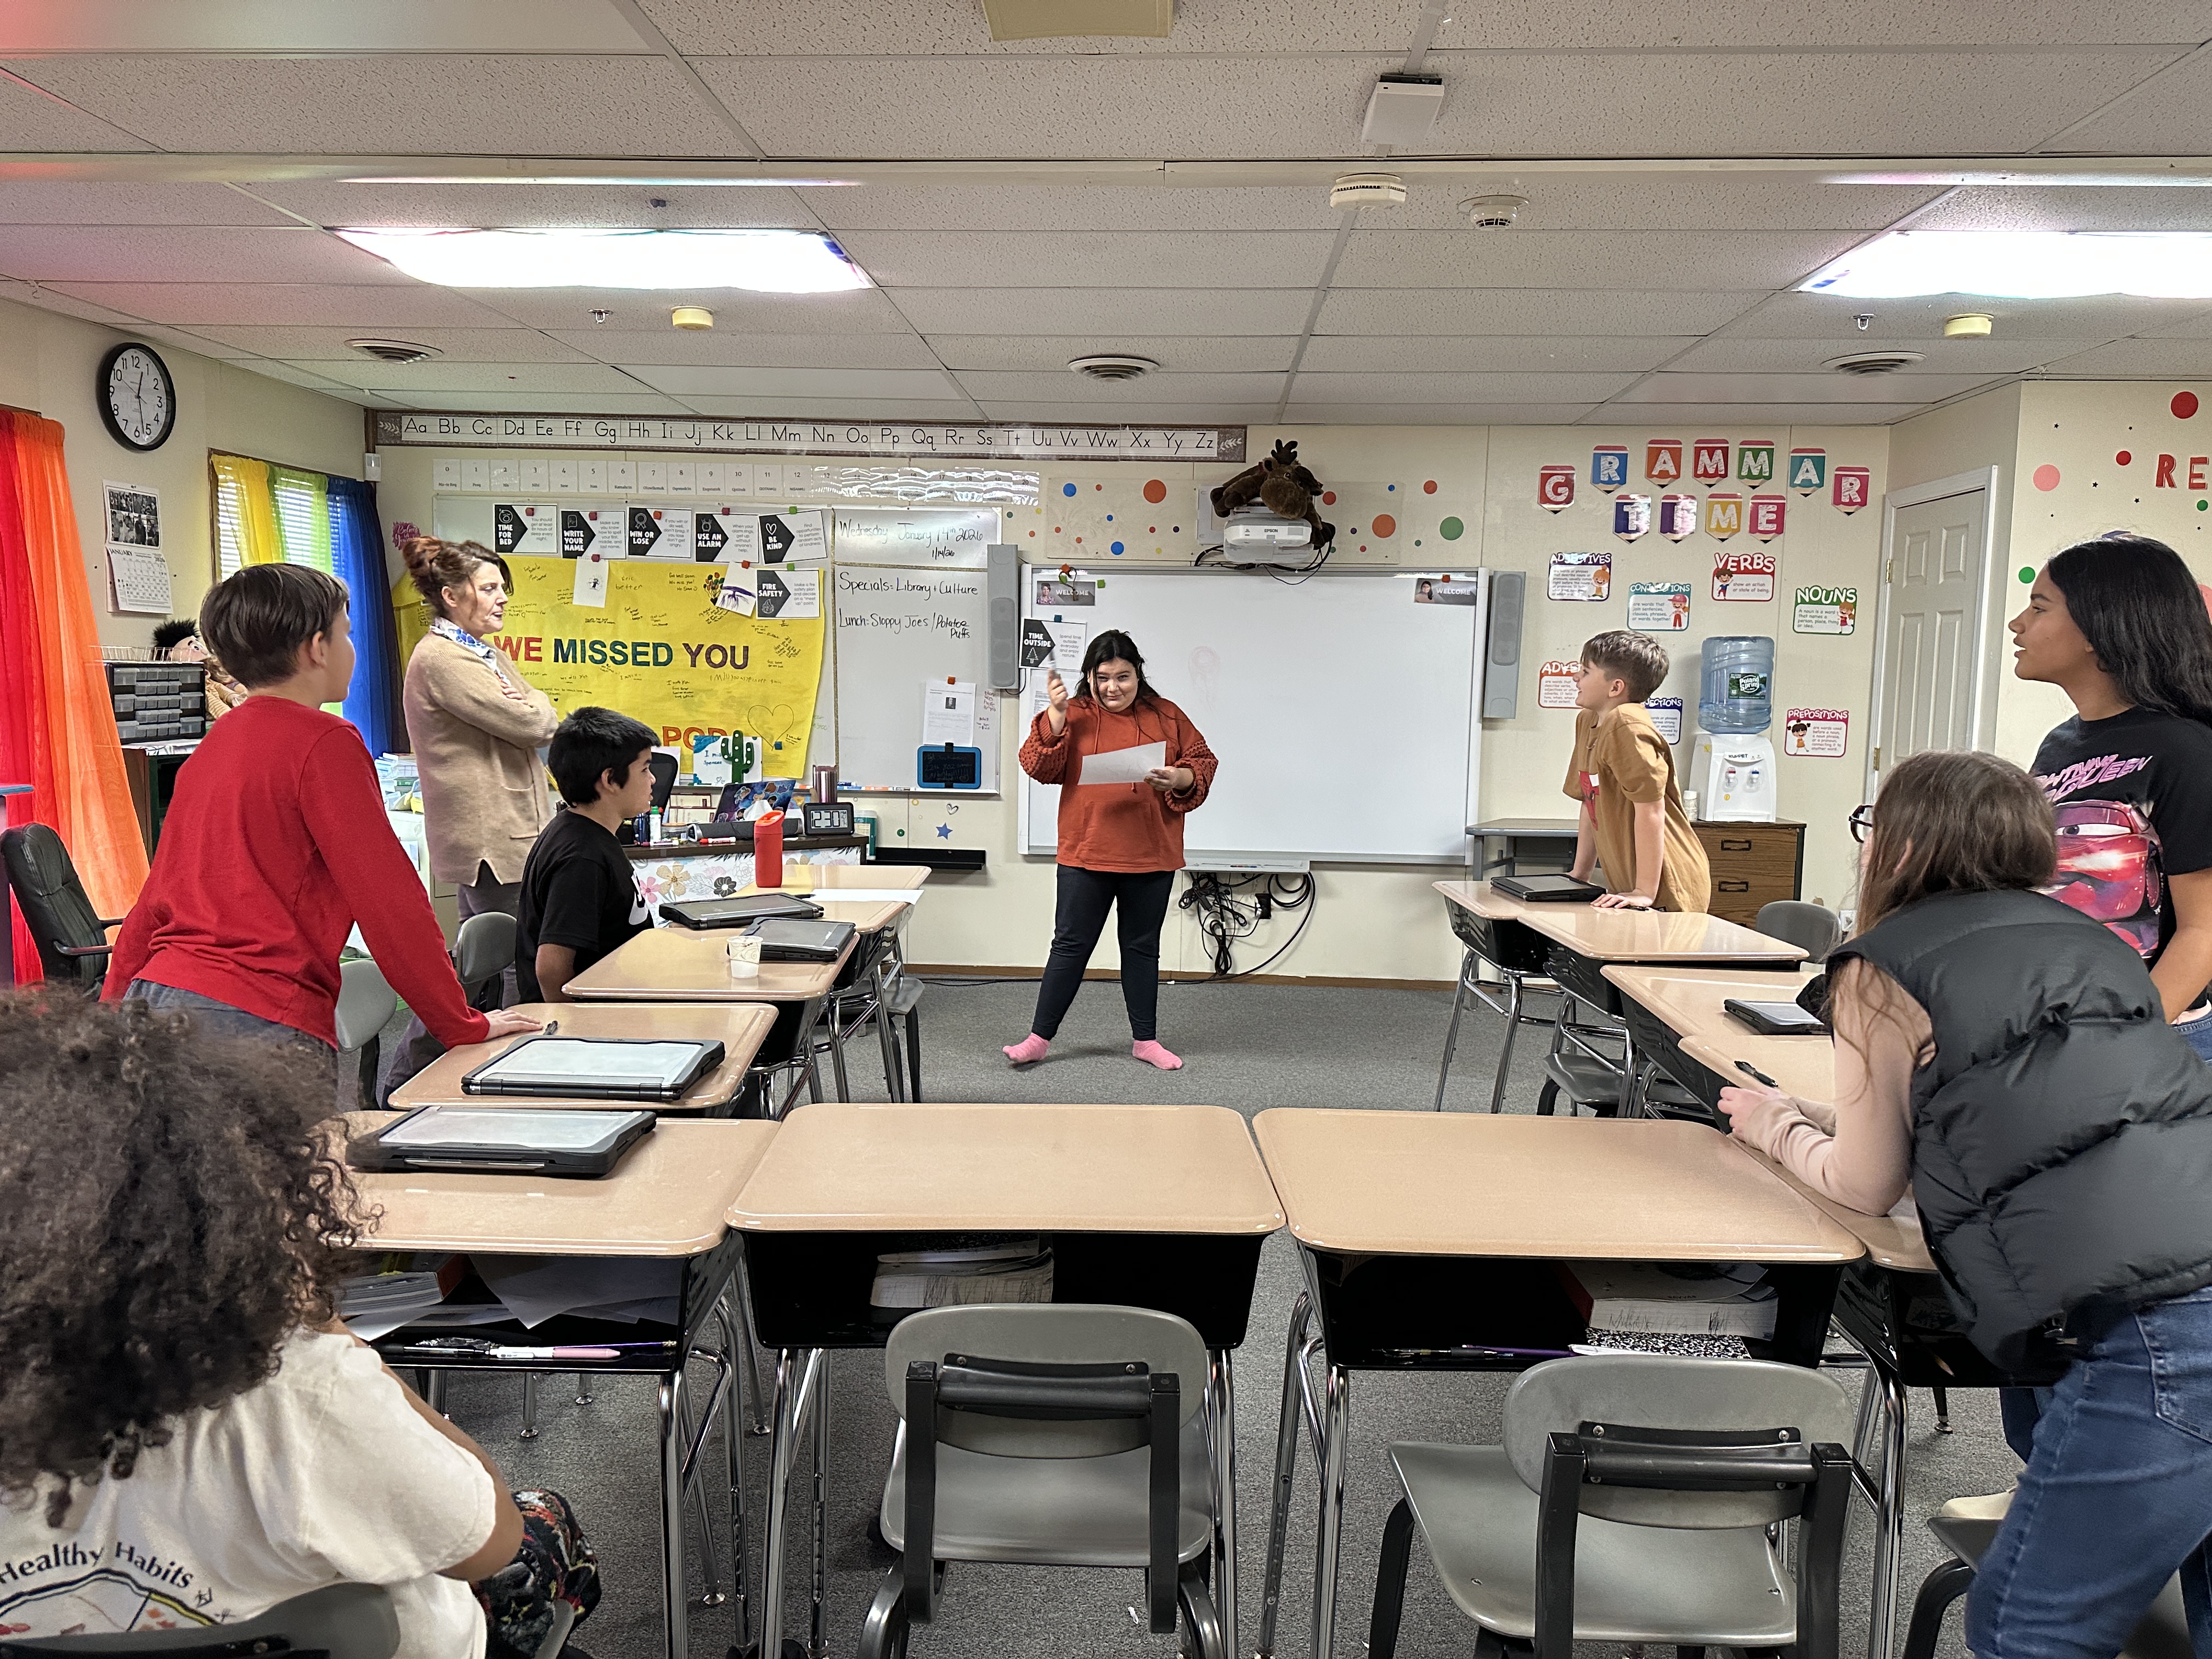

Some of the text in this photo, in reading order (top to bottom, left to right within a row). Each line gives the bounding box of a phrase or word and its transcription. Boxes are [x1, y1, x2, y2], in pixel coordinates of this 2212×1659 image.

[122, 357, 127, 370] 11
[131, 356, 140, 369] 12
[112, 368, 122, 381] 10
[146, 363, 149, 376] 1
[153, 378, 159, 390] 2
[110, 385, 115, 397] 9
[156, 396, 162, 408] 3
[113, 404, 119, 416] 8
[122, 419, 128, 431] 7
[154, 413, 159, 425] 4
[134, 426, 140, 438] 6
[145, 424, 151, 436] 5
[405, 417, 1214, 455] Aa Bb Cc Dd Ee Ff Gg Hh Ii Jj Kk Ll Mm Nn Oo Pp Qq Rr Ss Tt Uu Vv Ww Xx Yy Zz
[1545, 449, 1861, 503] GRAMMAR
[2155, 454, 2209, 490] RE
[1624, 504, 1776, 531] TIME
[839, 518, 888, 544] Wednesday
[897, 522, 932, 548] January
[956, 528, 983, 541] 2026
[1714, 552, 1776, 573] VERBS
[896, 577, 931, 601] Library
[939, 580, 978, 595] Culture
[1797, 586, 1857, 603] NOUNS
[870, 613, 901, 635] Sloppy
[904, 615, 928, 627] Joes
[950, 628, 970, 639] Puffs
[1024, 639, 1051, 647] OUTSIDE
[494, 636, 543, 662] WE
[553, 638, 673, 667] MISSED
[682, 642, 749, 670] YOU
[1739, 675, 1759, 684] Poland
[1740, 682, 1760, 691] Spring
[1645, 698, 1682, 707] JECTIONS
[1788, 709, 1848, 720] PREPOSITIONS
[0, 1541, 195, 1589] Healthy Habits
